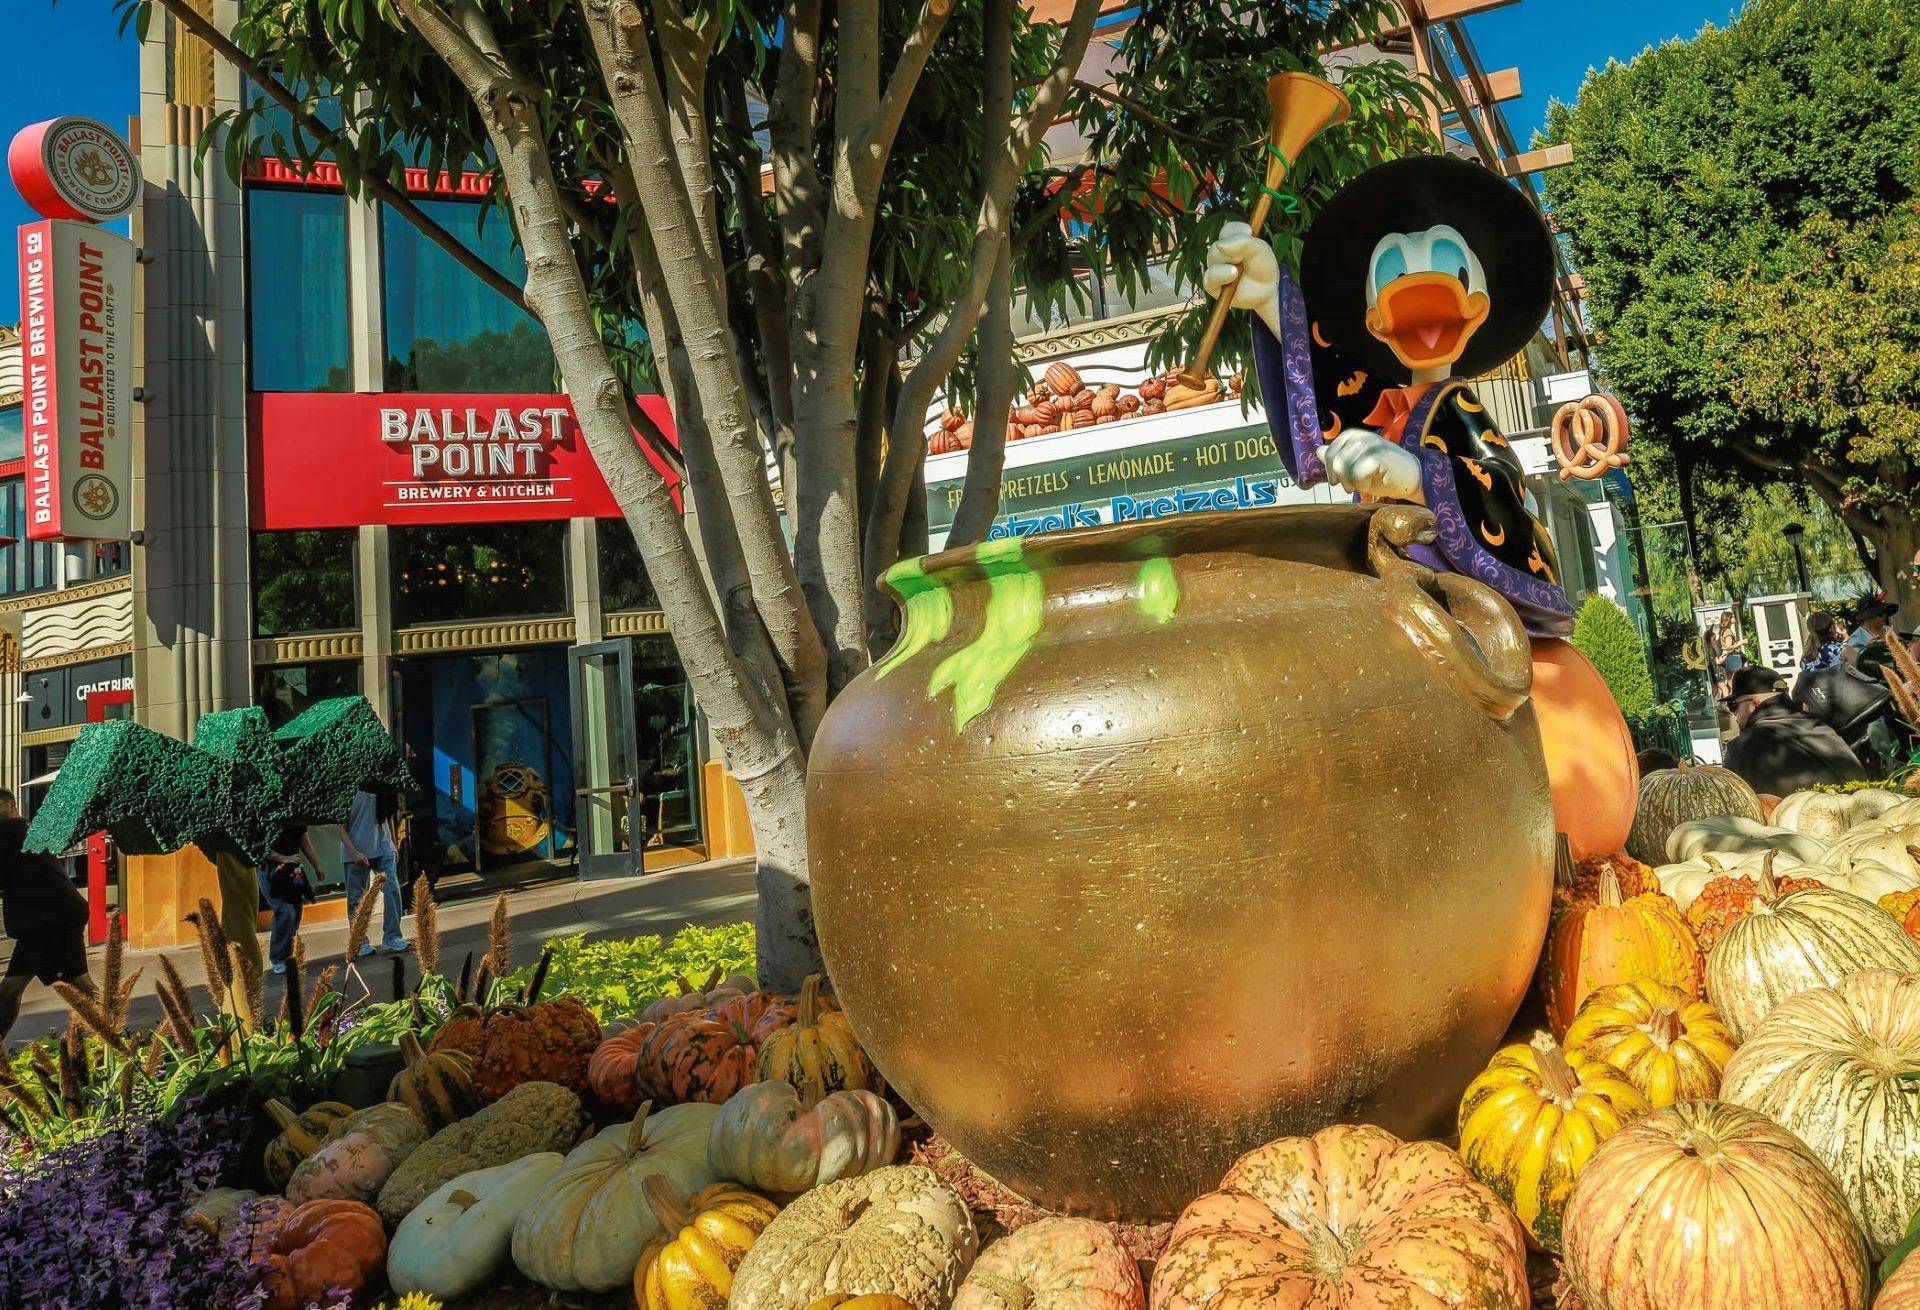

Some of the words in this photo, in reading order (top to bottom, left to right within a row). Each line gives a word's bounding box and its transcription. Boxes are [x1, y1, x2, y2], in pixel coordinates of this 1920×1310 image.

[58, 131, 100, 153] BALLAST
[103, 140, 129, 175] POINT
[95, 184, 127, 204] COMPANY
[27, 258, 46, 357] BREWING
[79, 239, 104, 334] POINT
[105, 296, 114, 327] CRAFT
[106, 332, 115, 349] THE
[106, 353, 115, 368] TO
[30, 364, 49, 426] POINT
[79, 337, 105, 470] BALLAST
[106, 370, 117, 425] DEDICATED
[380, 408, 569, 441] BALLAST
[32, 432, 51, 524] BALLAST
[412, 443, 543, 477] POINT
[1000, 470, 1069, 500] PRETZELS
[1088, 452, 1175, 485] LEMONADE
[1196, 443, 1228, 467] HOT
[1235, 436, 1277, 461] DOGS
[398, 485, 472, 500] BREWERY
[476, 485, 487, 498] &
[492, 484, 555, 497] KITCHEN
[986, 504, 1101, 542] etzel's
[1111, 476, 1277, 523] Pretzels
